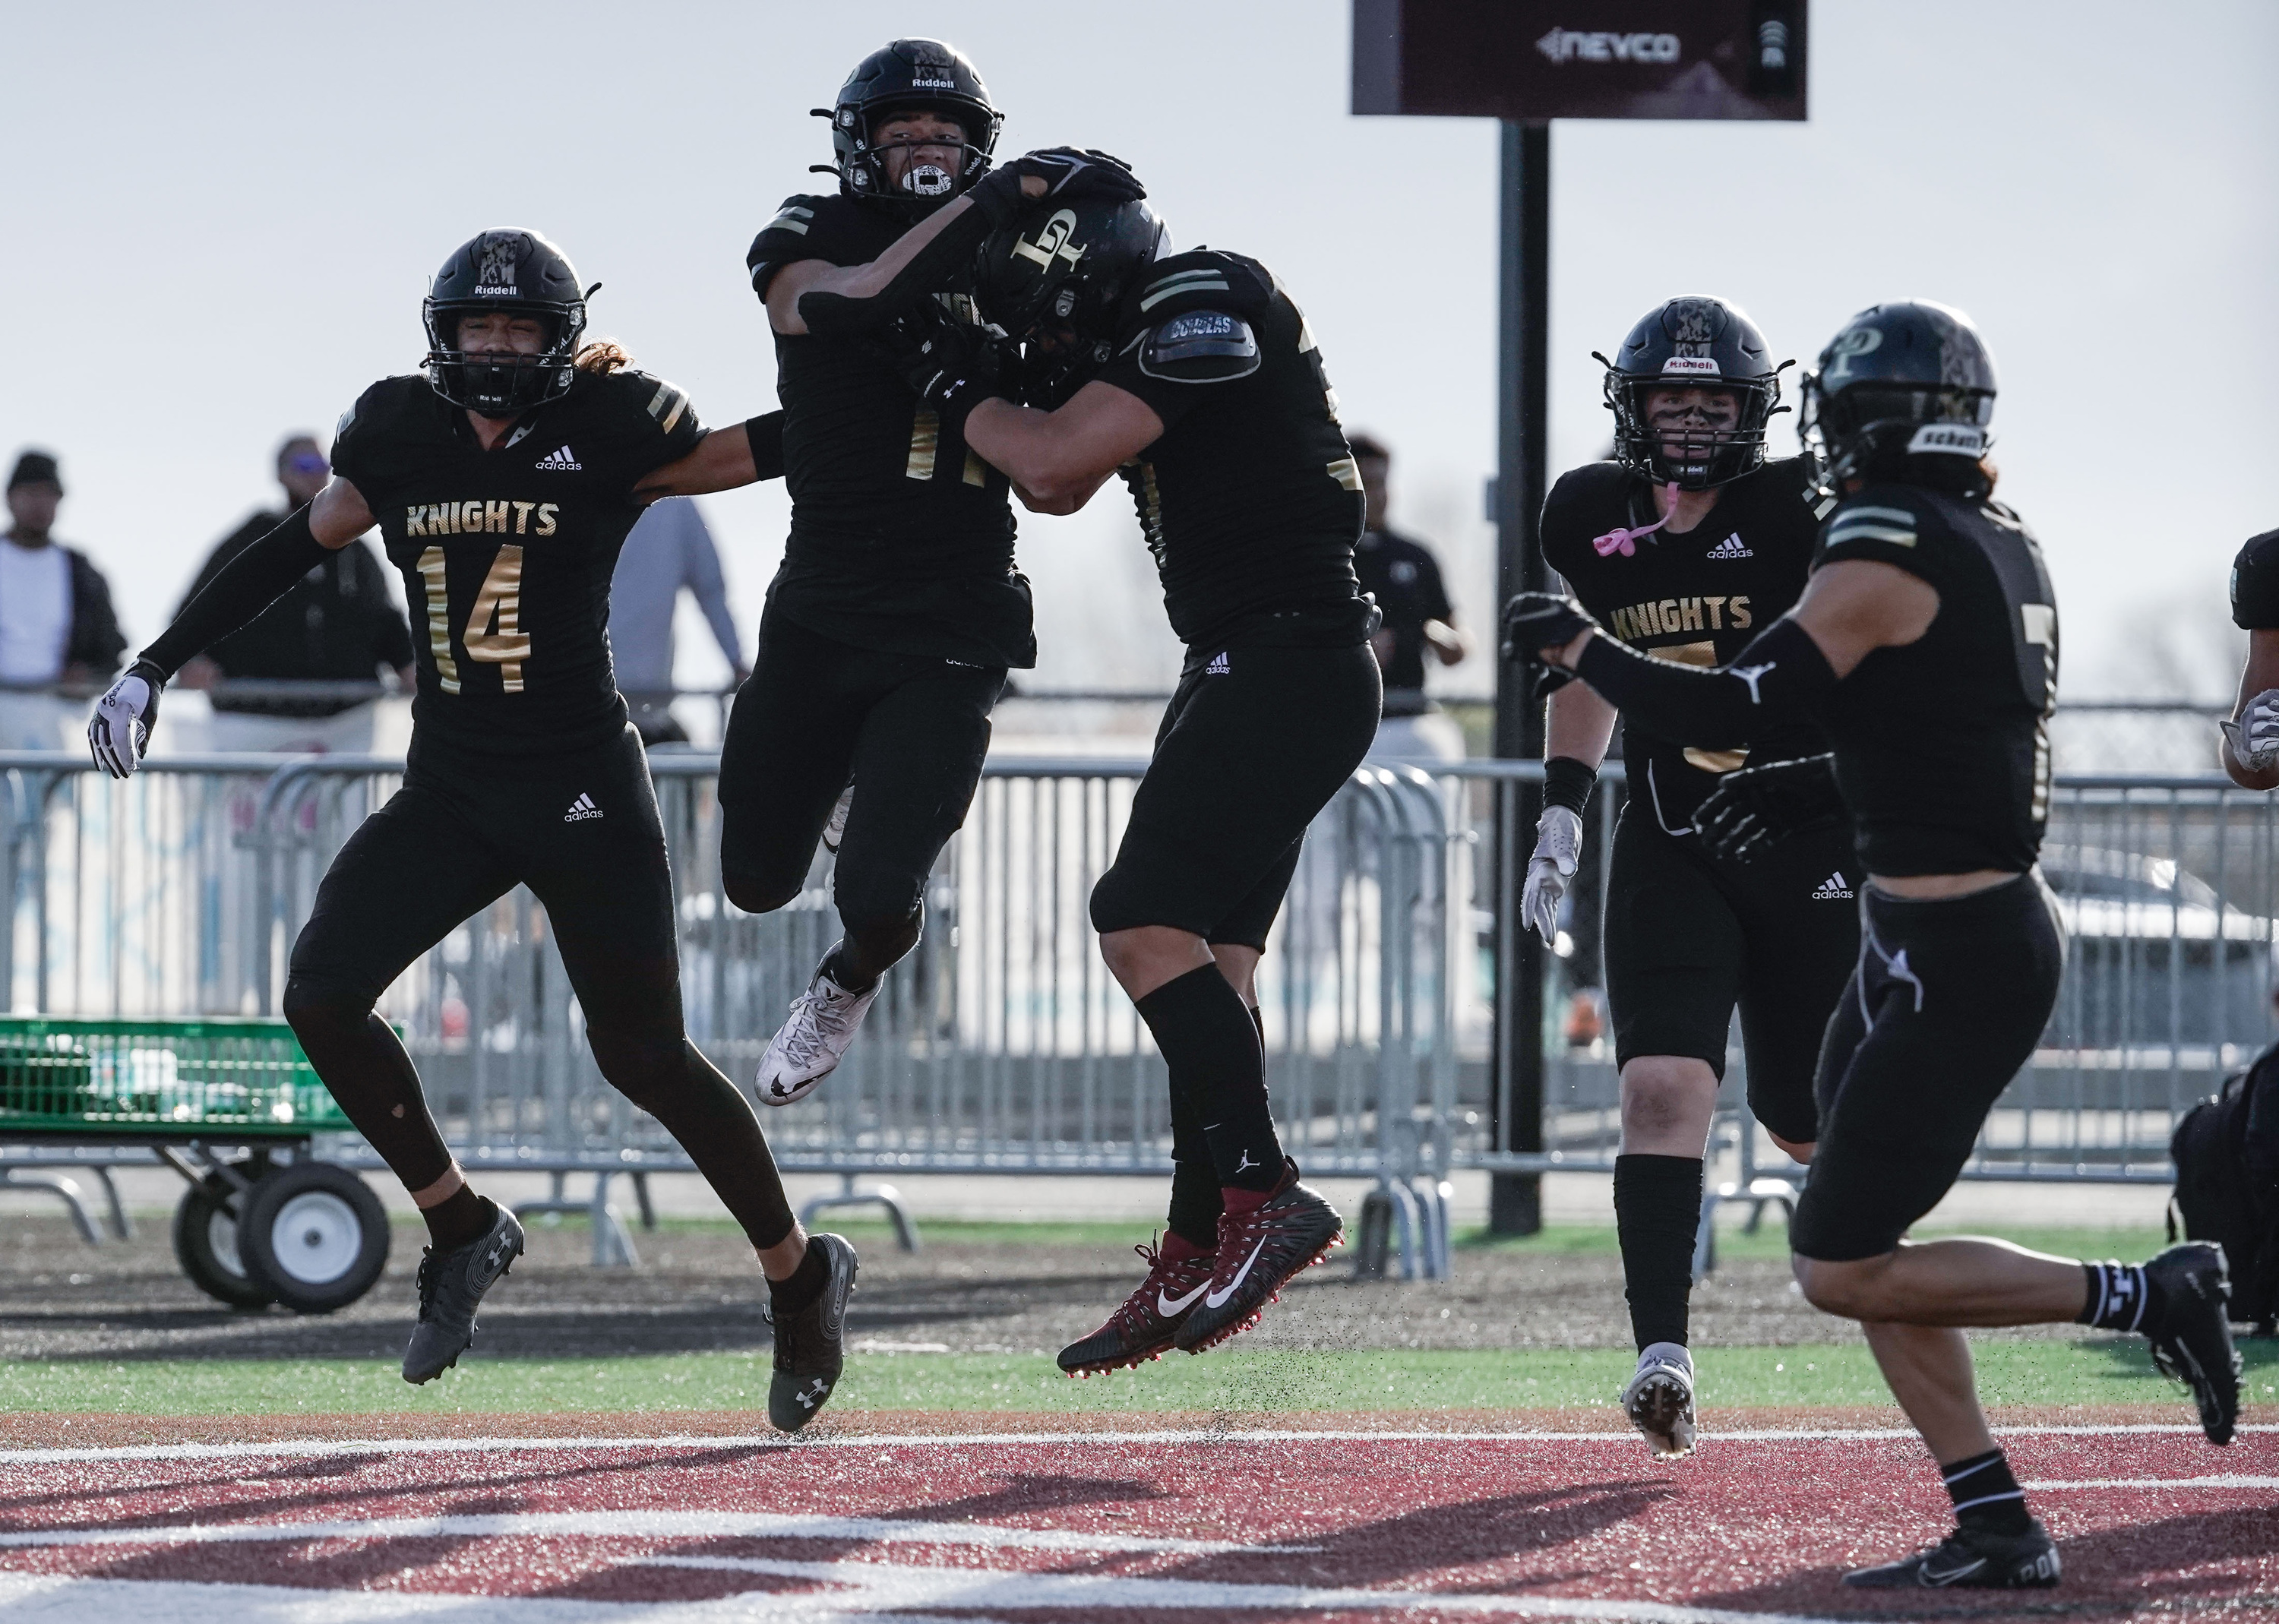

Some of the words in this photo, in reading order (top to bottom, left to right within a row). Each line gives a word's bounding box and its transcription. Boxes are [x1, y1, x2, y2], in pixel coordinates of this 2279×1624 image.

[912, 79, 954, 88] Riddell
[474, 285, 517, 295] Riddell
[1170, 317, 1231, 339] DOUGLAS
[536, 460, 582, 470] adidas
[407, 501, 559, 537] KNIGHTS
[1707, 548, 1753, 559] adidas
[416, 544, 531, 694] 14
[1610, 596, 1753, 641] KNIGHTS
[564, 810, 604, 822] adidas
[1812, 889, 1854, 899] adidas
